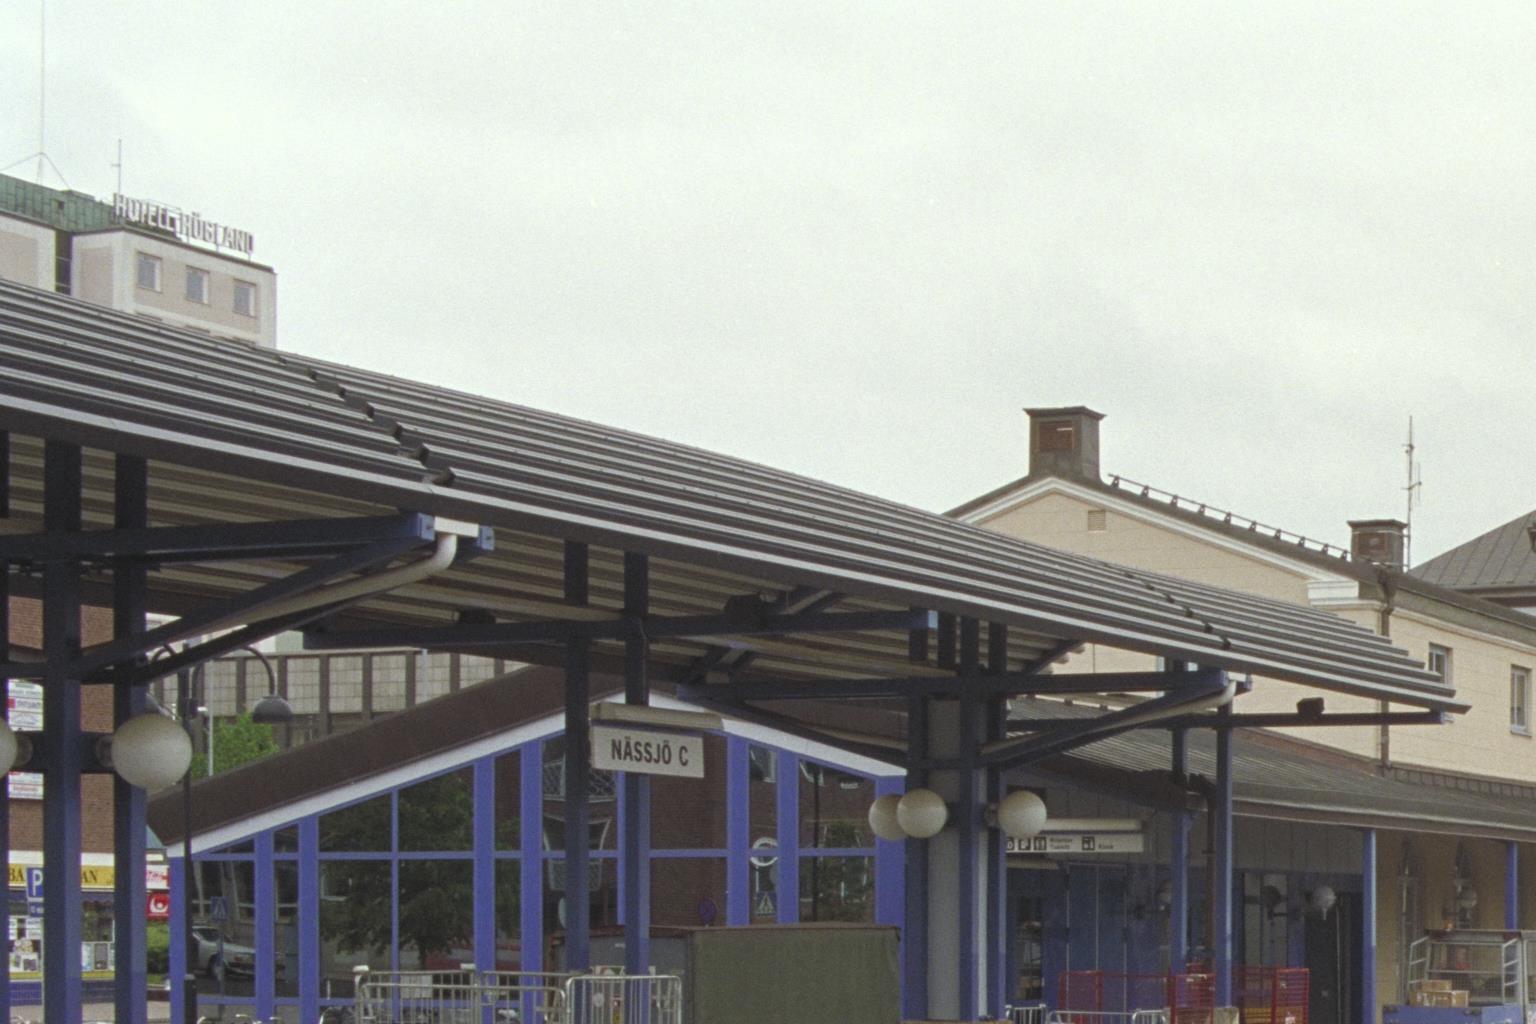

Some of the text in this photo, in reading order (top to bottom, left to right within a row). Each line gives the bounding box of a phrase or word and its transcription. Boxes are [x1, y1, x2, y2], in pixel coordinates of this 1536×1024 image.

[611, 735, 689, 767] NÄSSJÖ C
[31, 868, 43, 897] P
